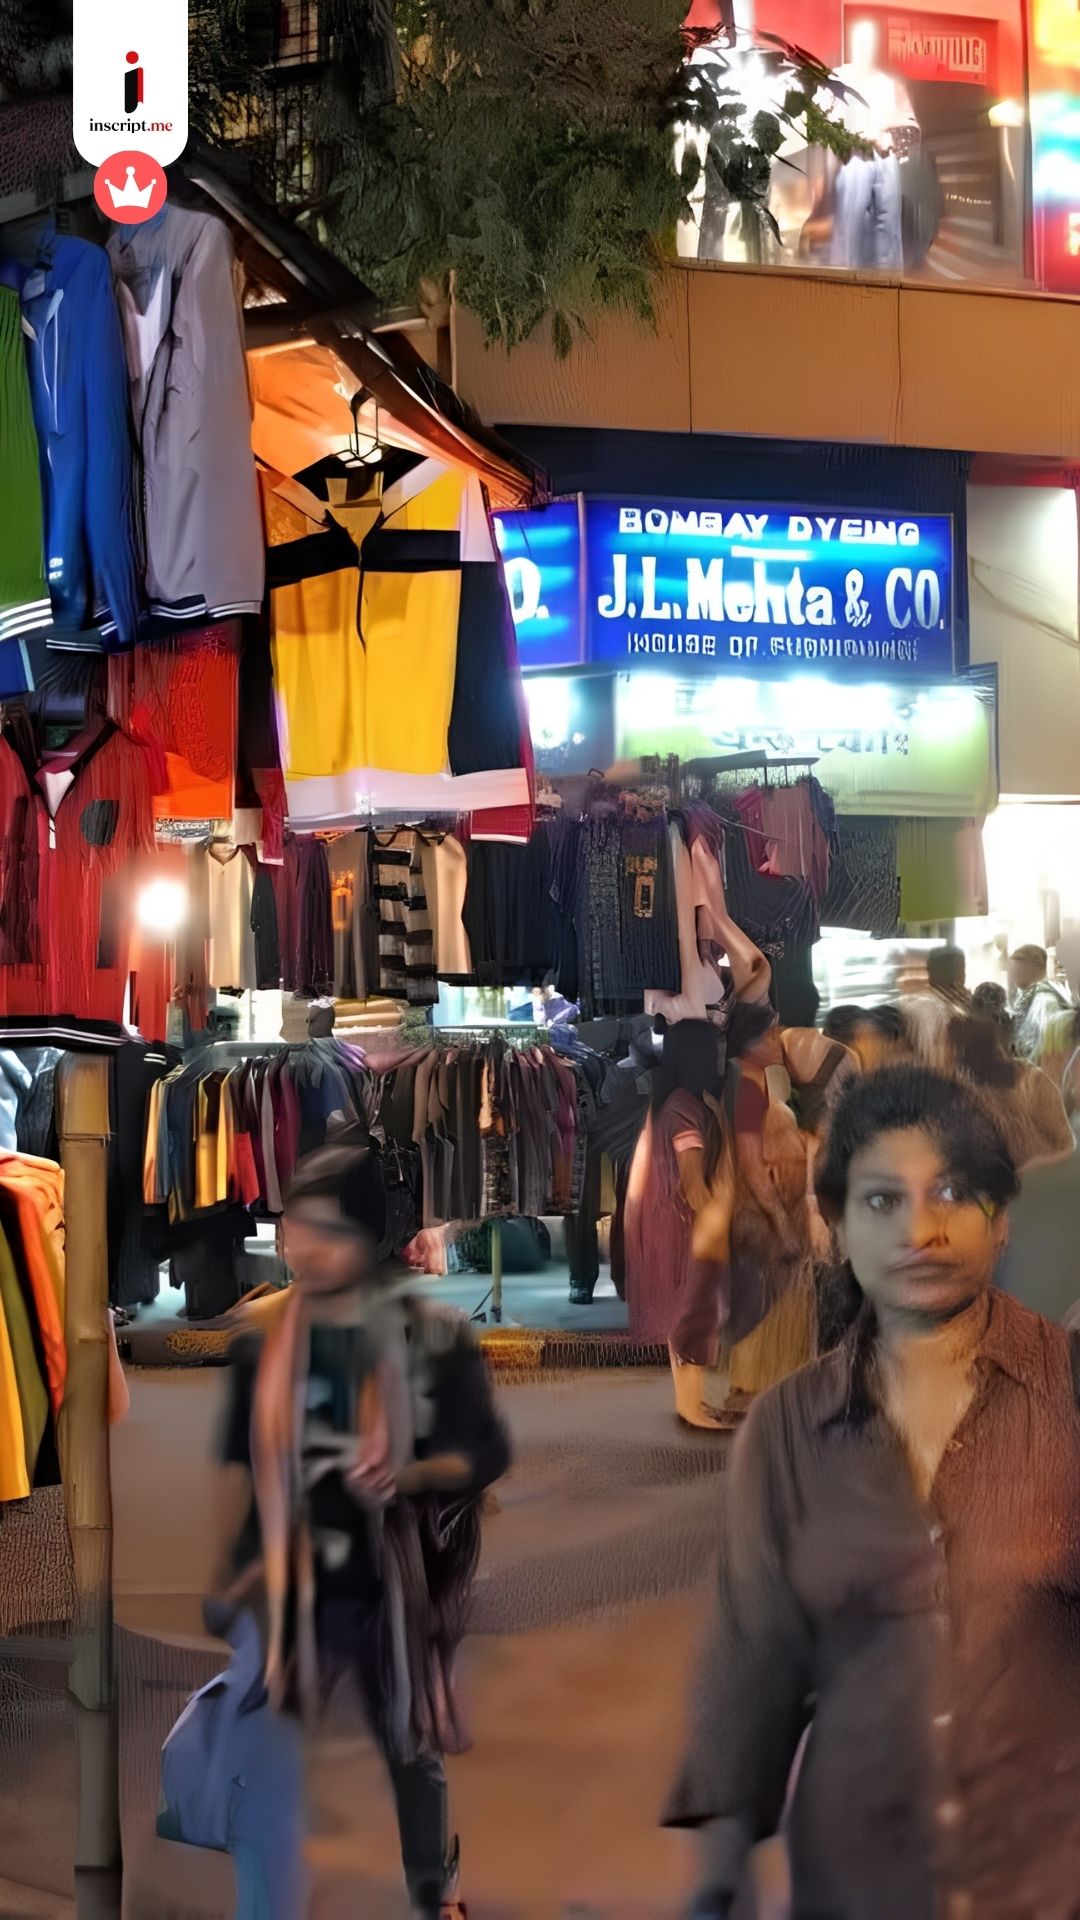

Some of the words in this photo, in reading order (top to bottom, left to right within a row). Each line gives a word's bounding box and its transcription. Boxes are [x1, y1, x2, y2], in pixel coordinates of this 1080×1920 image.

[619, 508, 768, 540] BOMBAY
[787, 516, 920, 546] DYEING
[845, 568, 872, 627] &
